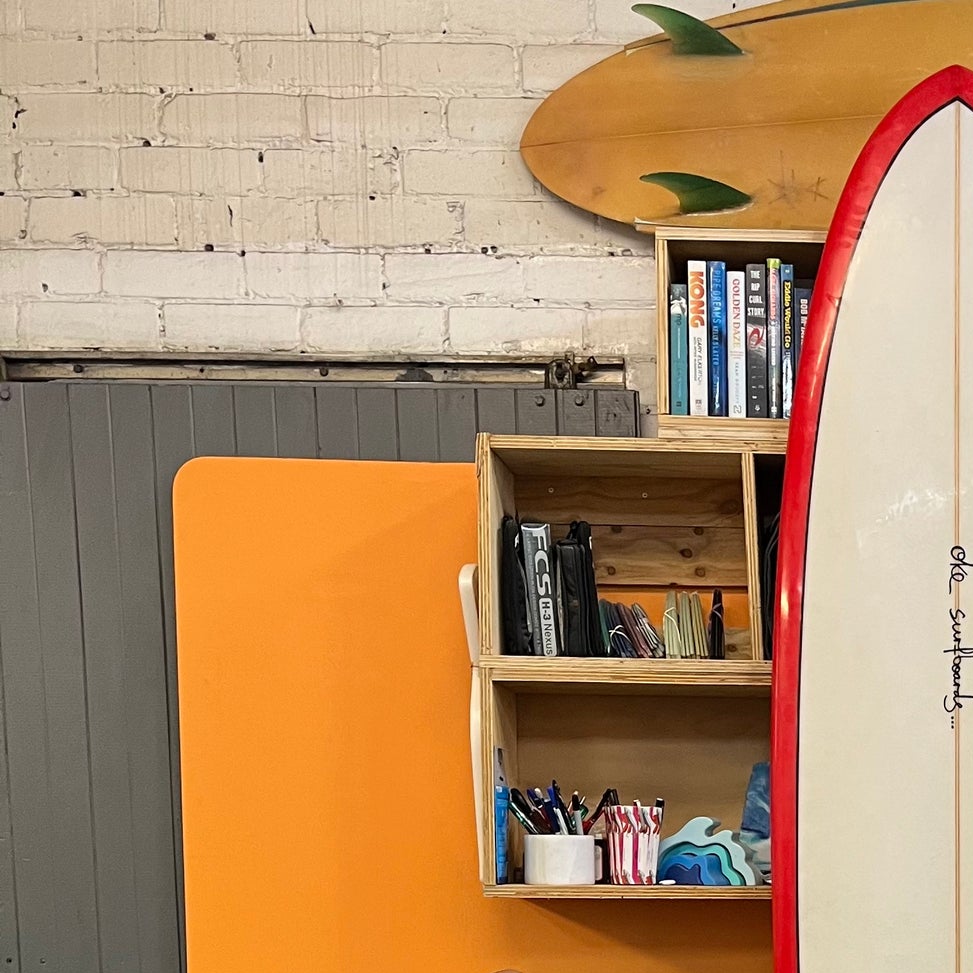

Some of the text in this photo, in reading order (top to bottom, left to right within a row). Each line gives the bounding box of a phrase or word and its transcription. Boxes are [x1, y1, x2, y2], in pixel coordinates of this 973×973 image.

[690, 271, 704, 328] KONG
[749, 296, 762, 304] CURL
[751, 282, 759, 291] RIP
[713, 290, 721, 323] DREAMS
[748, 308, 764, 316] STORY
[733, 324, 741, 352] DAZE
[784, 336, 791, 348] Go
[532, 529, 551, 596] FCS
[542, 601, 553, 655] H-3 Nexus
